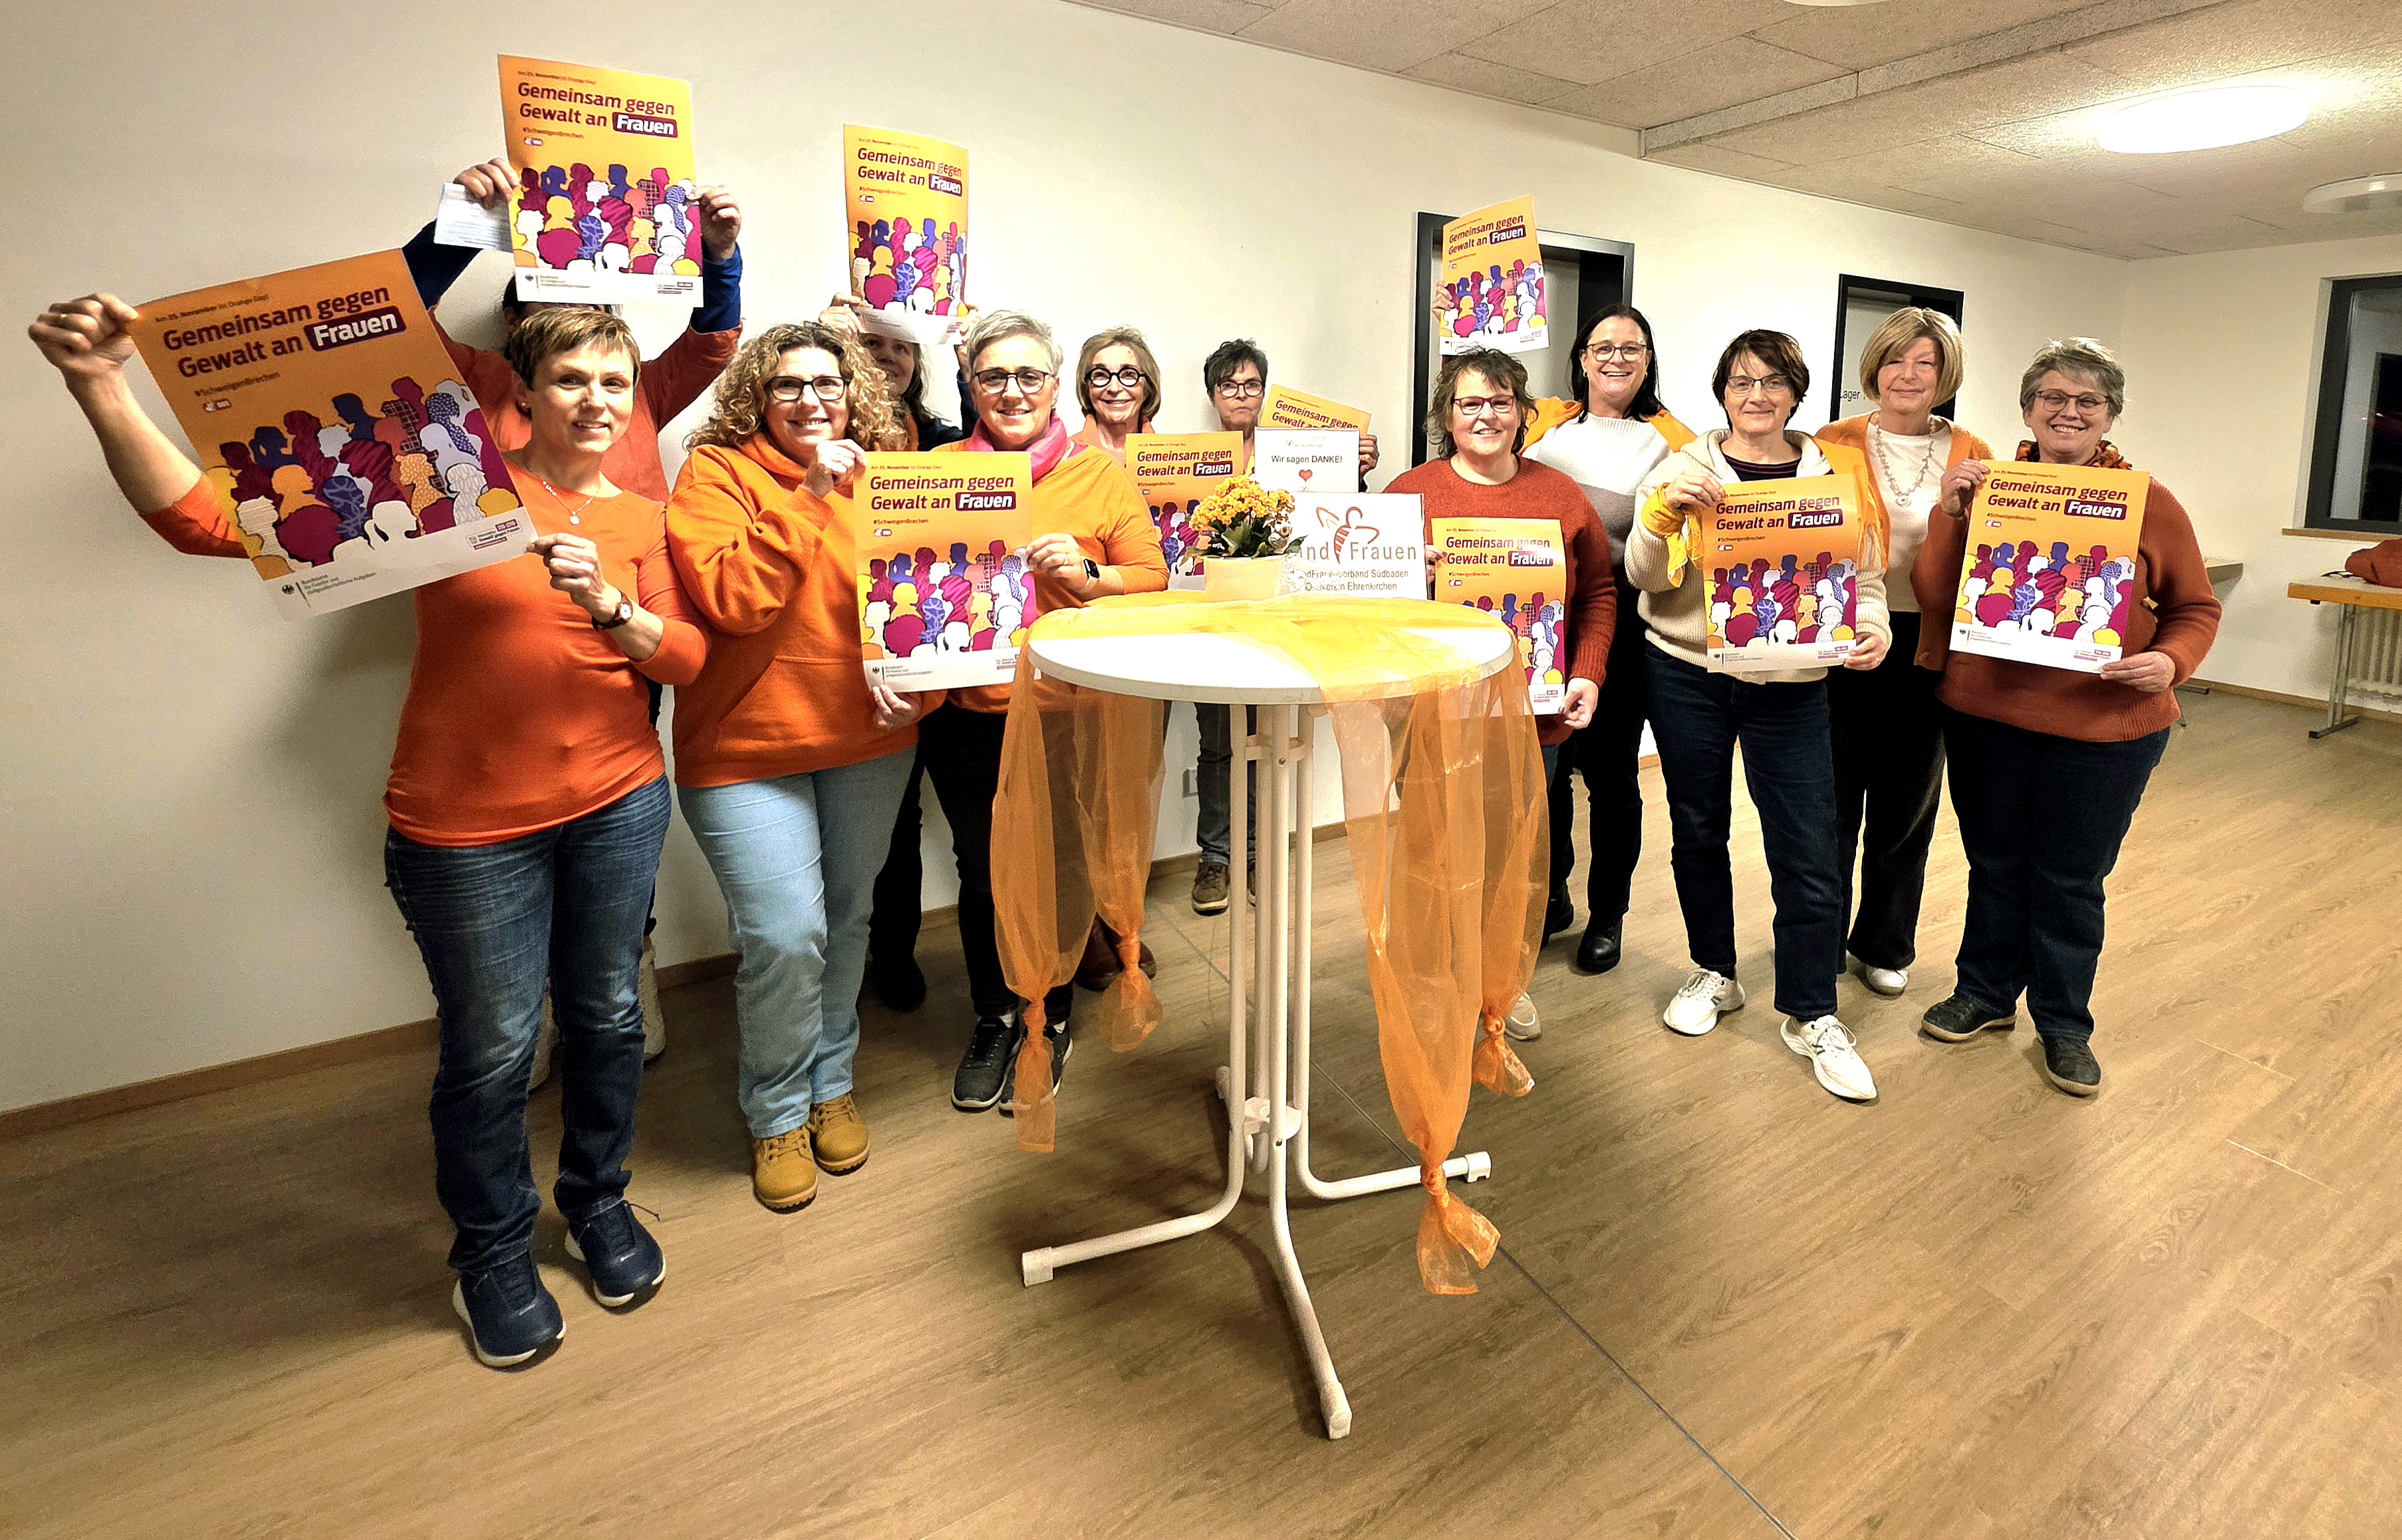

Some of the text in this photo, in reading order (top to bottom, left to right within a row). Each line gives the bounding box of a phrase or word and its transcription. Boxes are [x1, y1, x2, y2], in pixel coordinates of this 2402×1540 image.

[517, 82, 674, 115] Gemeinsam gegen
[520, 103, 674, 135] Gewalt an Frauen
[858, 148, 962, 178] Gemeinsam gegen
[858, 166, 961, 194] Gewalt an Frauen
[1449, 223, 1494, 243] Gemeinsam
[1496, 215, 1523, 230] gegen
[1448, 228, 1523, 255] Gewalt an Frauen
[164, 287, 390, 350] Gemeinsam gegen
[178, 313, 398, 378] Gewalt an Frauen
[1840, 390, 1860, 402] ager
[1272, 412, 1305, 428] Gewalt
[1275, 400, 1330, 423] Gemeinsam
[1138, 450, 1232, 461] Gemeinsam gegen
[1137, 463, 1230, 476] Gewalt an Frauen
[870, 475, 1013, 491] Gemeinsam gegen
[1990, 479, 2127, 501] Gemeinsam gegen
[871, 493, 1013, 510] Gewalt an Frauen
[1716, 497, 1839, 514] Gemeinsam gegen
[1988, 495, 2123, 518] Gewalt an Frauen
[1716, 513, 1839, 530] Gewalt an Frauen
[1350, 541, 1416, 560] Frauen
[1446, 537, 1514, 548] Gemeinsam
[1447, 552, 1550, 565] Gewalt an Frauen
[1371, 569, 1408, 578] Südbaden
[1347, 581, 1397, 590] Ehrenkirchen
